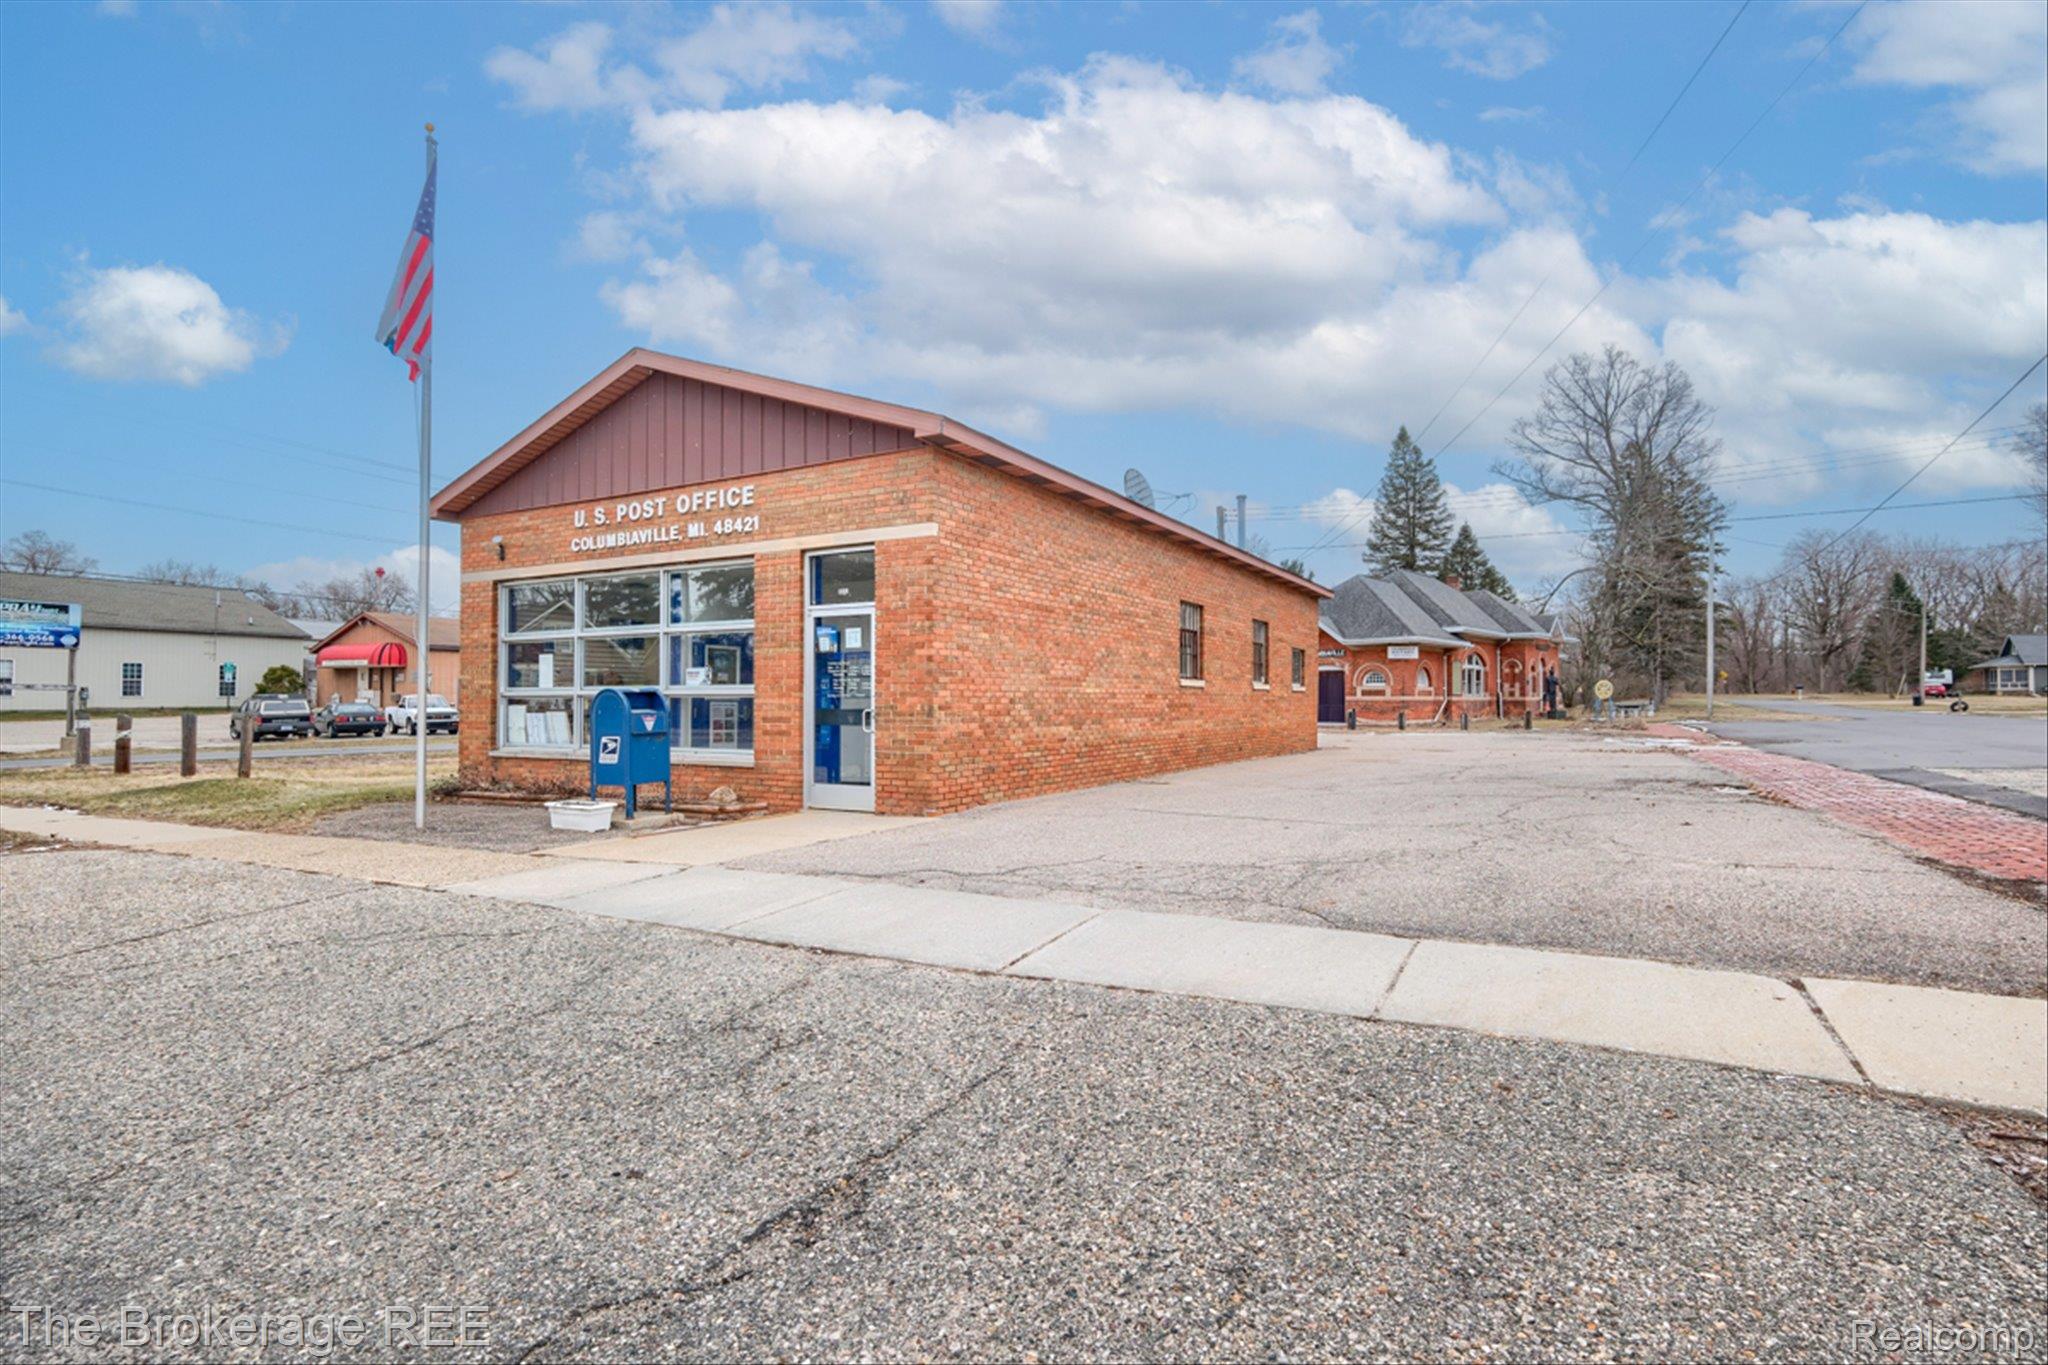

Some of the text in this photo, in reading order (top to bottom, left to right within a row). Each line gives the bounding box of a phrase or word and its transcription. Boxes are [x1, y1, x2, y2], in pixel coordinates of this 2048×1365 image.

[574, 485, 755, 528] U. S. POST OFFICE
[714, 515, 760, 535] 48421
